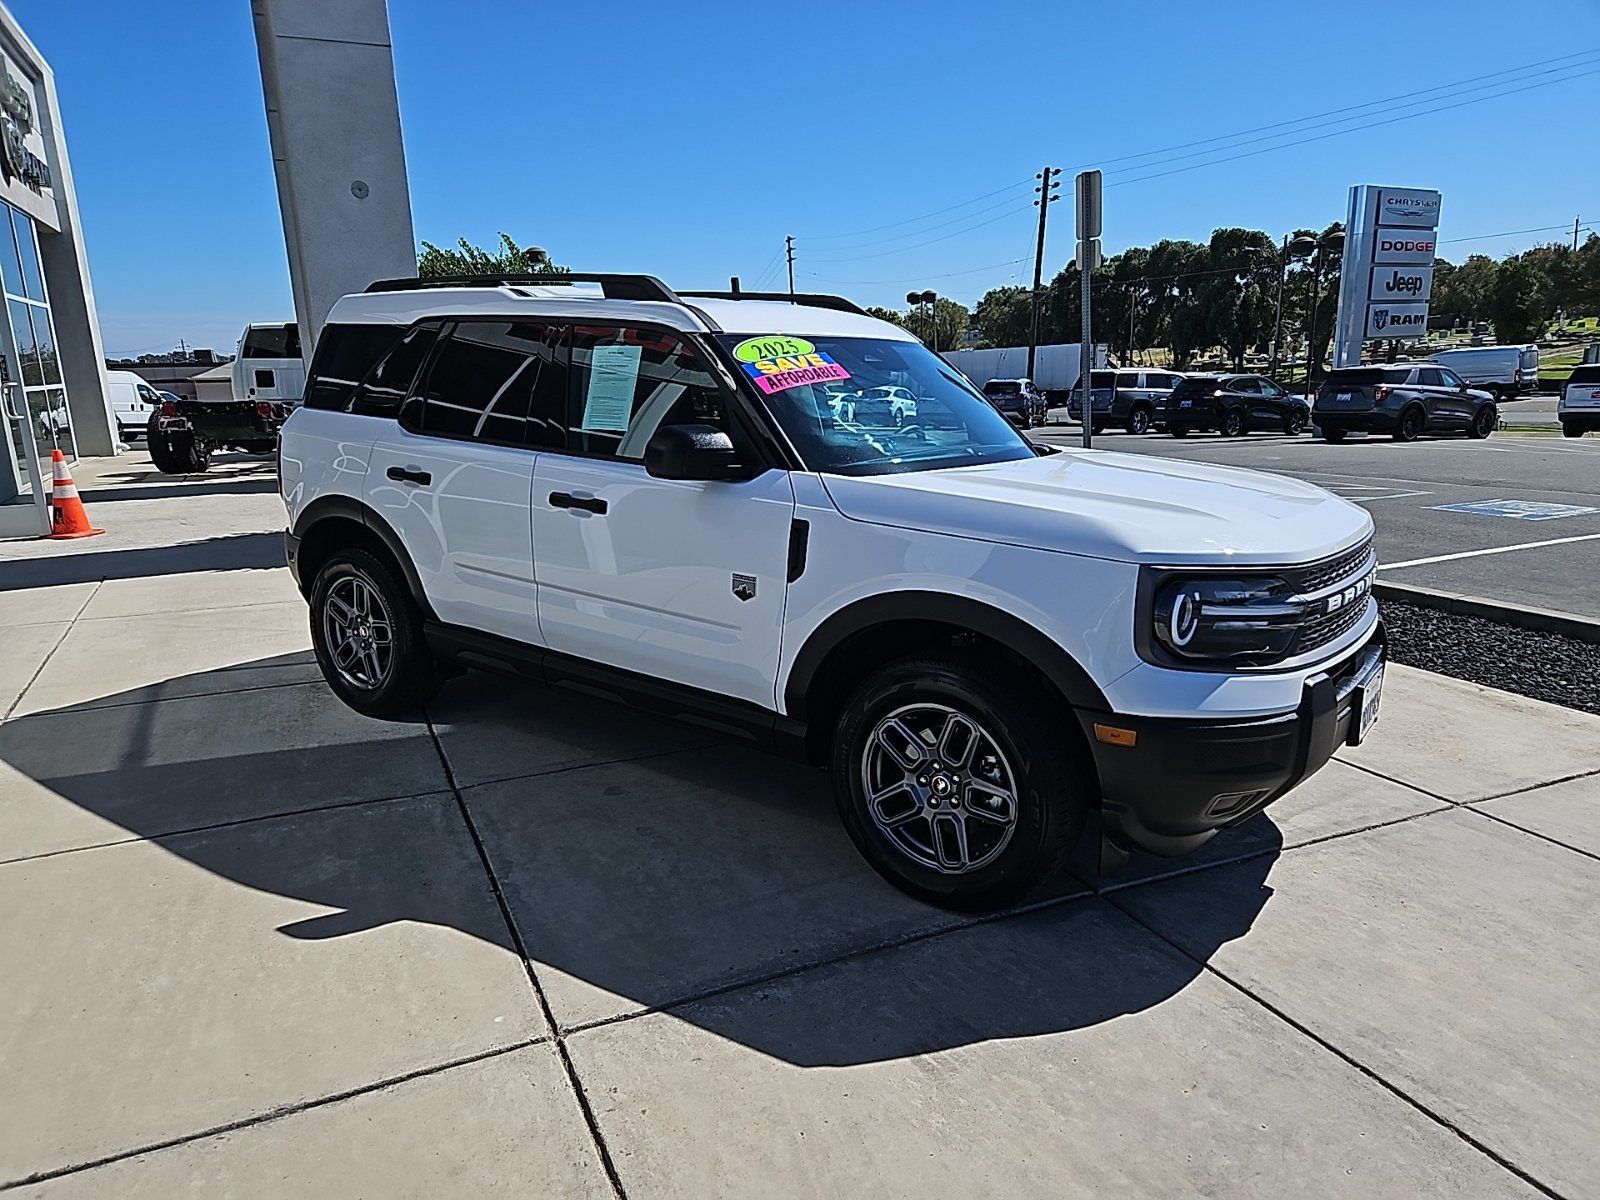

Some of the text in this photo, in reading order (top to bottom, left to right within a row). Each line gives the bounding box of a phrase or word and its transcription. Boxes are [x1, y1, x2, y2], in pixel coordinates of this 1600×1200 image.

[1387, 197, 1438, 208] CHRYSLER
[1381, 241, 1433, 252] DODGE
[1385, 271, 1422, 296] Jeep
[1389, 314, 1425, 326] RAM
[751, 340, 799, 359] 2025
[755, 353, 828, 374] SAVE
[764, 365, 840, 389] AFFORDABLE
